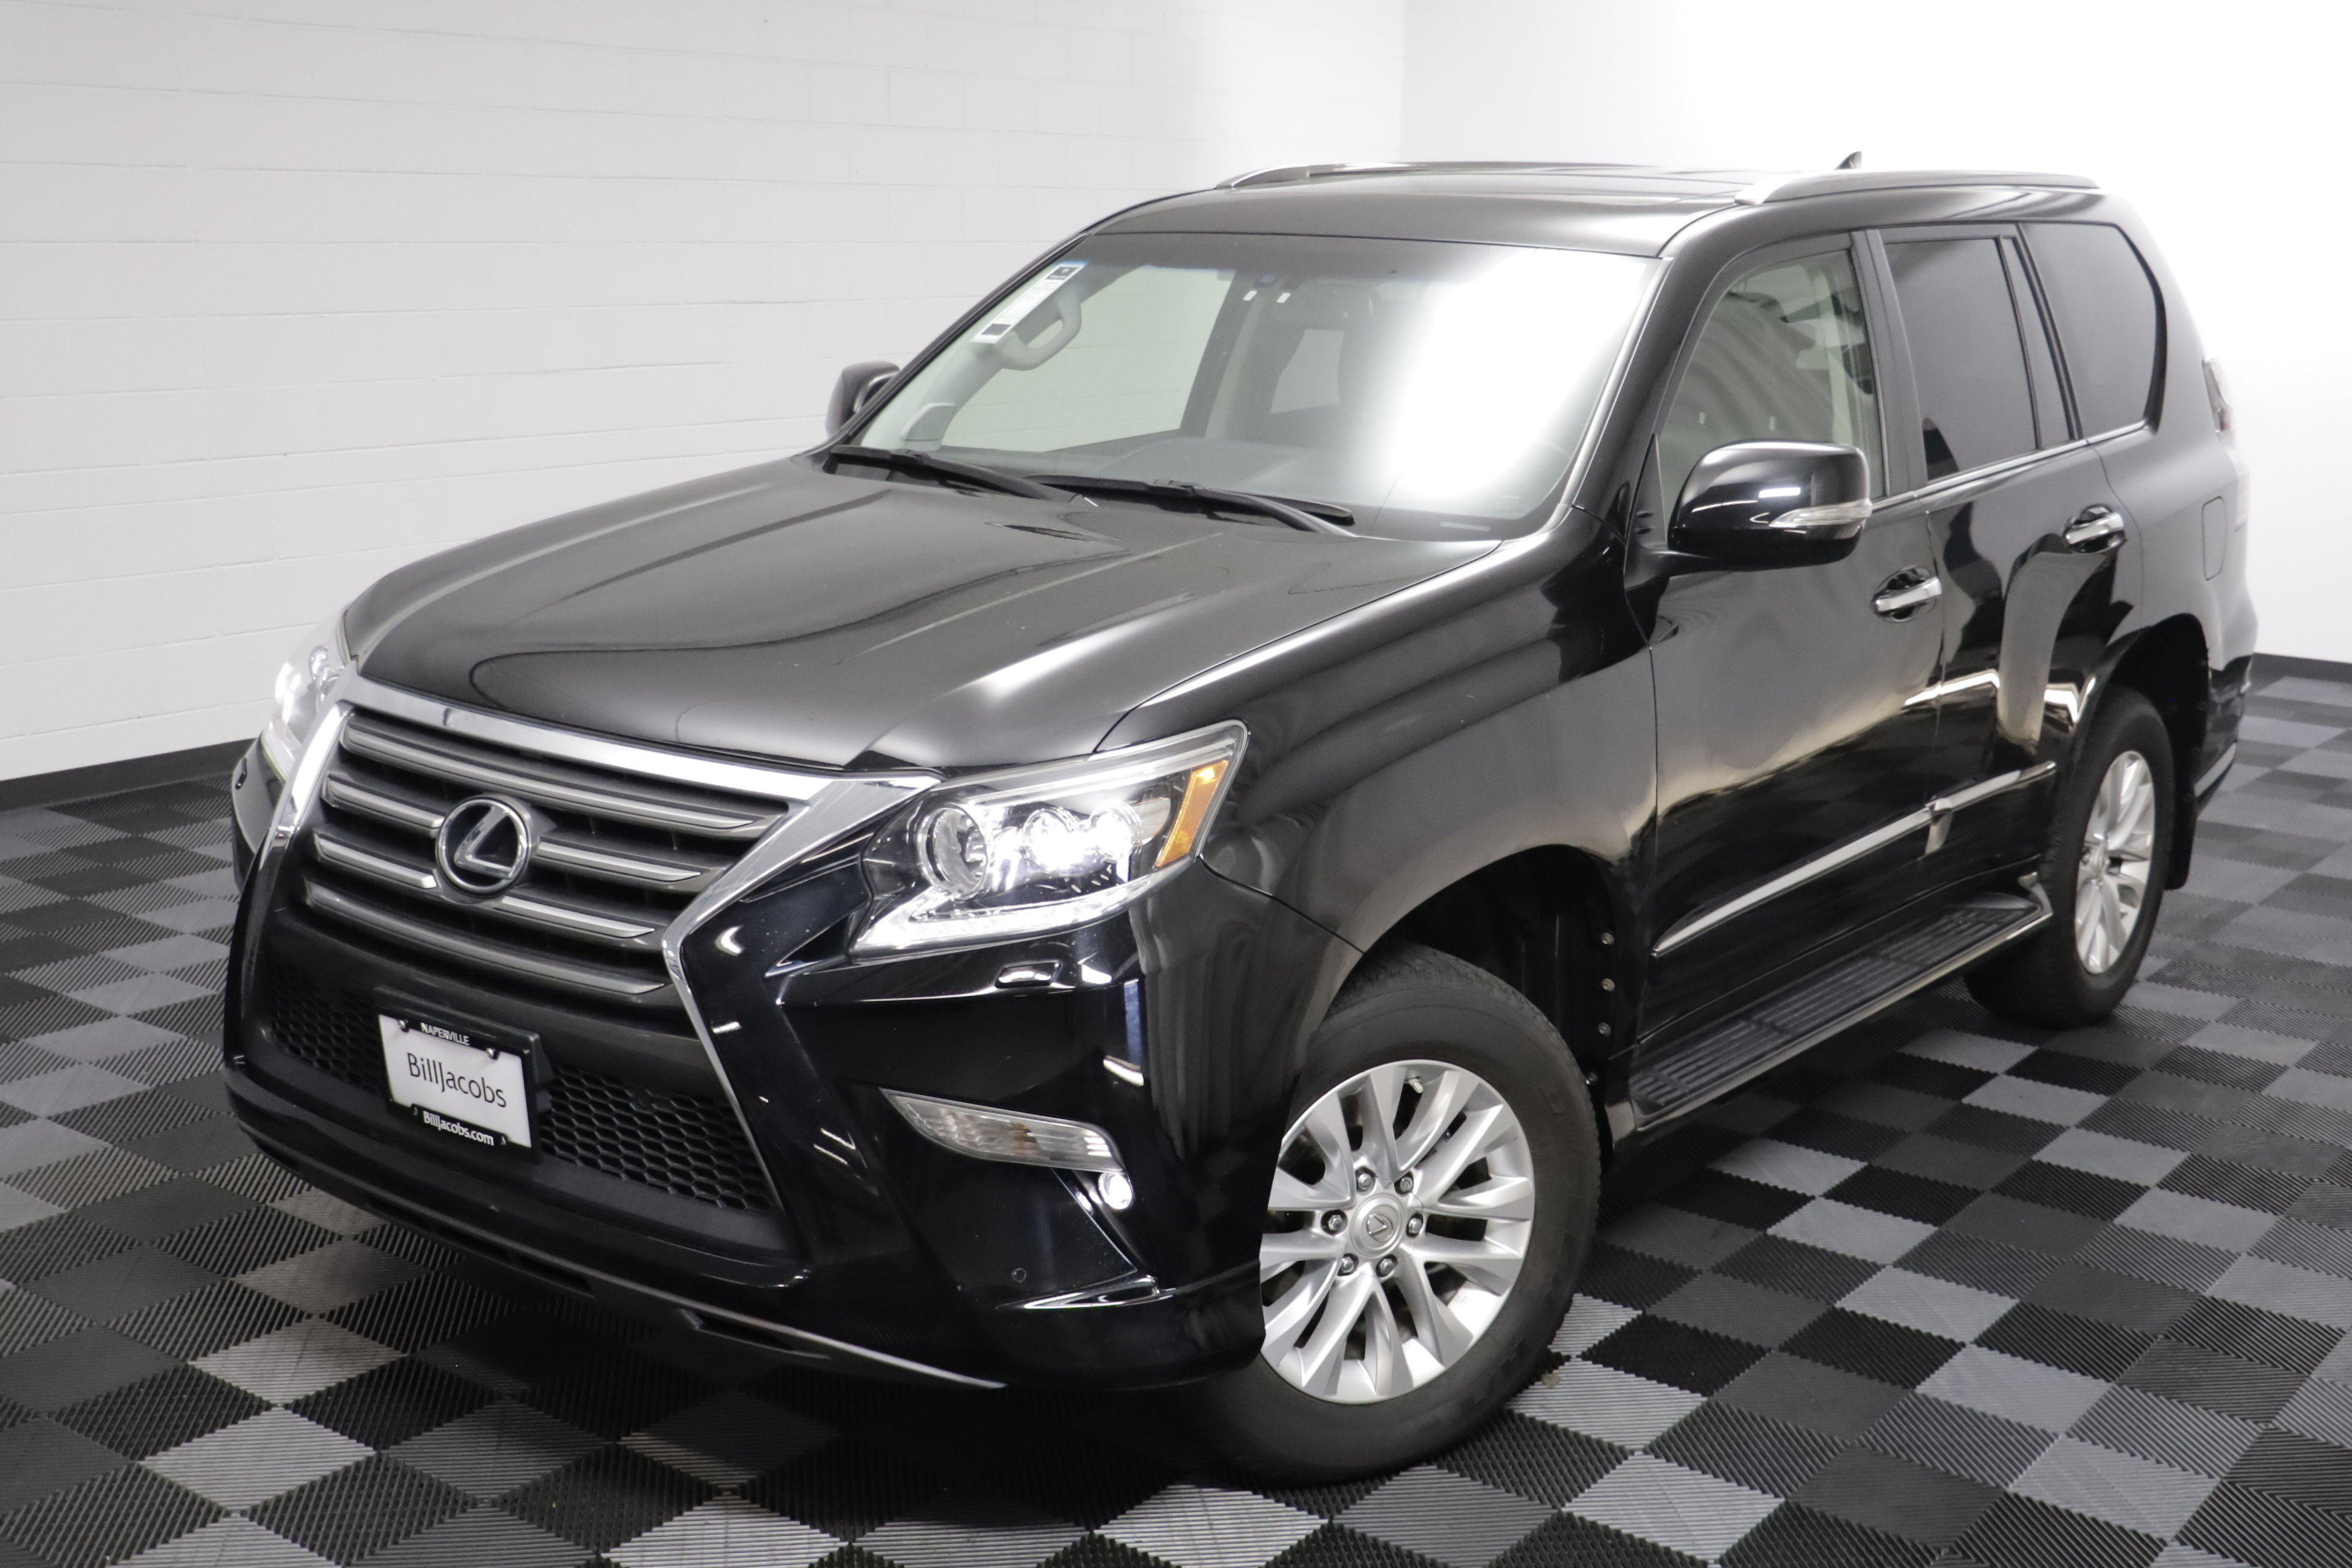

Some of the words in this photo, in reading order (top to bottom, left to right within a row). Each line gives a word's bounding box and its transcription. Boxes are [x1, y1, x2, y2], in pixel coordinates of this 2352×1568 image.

[420, 1022, 470, 1046] NAPERVILLE
[407, 1052, 507, 1108] BillJacobs
[423, 1110, 494, 1146] BillJacobs.com
